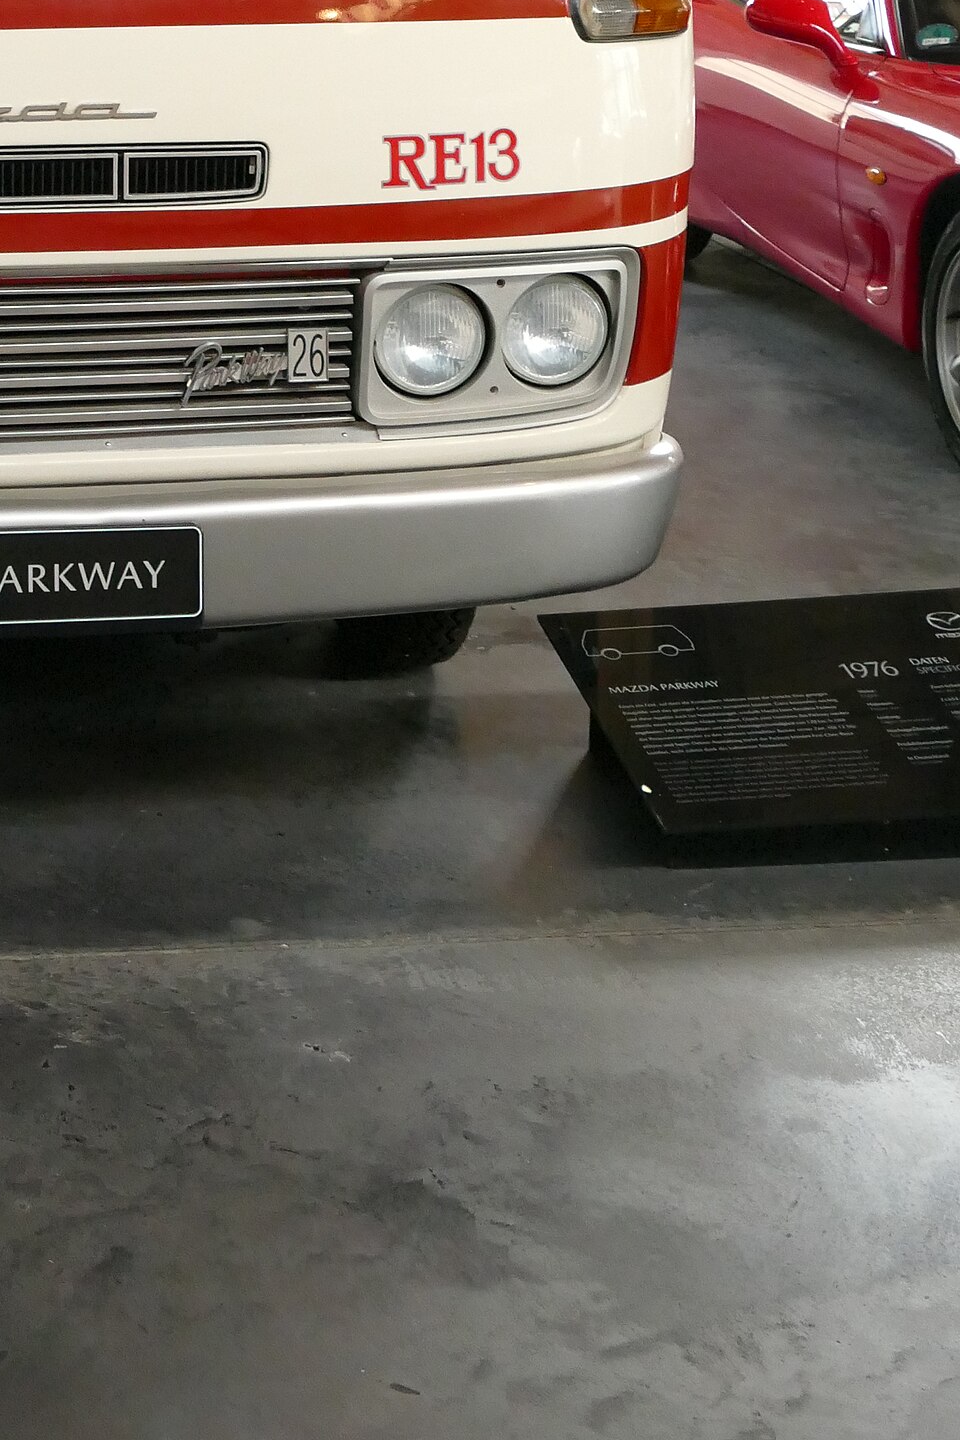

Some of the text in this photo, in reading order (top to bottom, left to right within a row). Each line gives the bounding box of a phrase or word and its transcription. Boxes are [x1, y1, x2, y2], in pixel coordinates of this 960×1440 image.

[381, 127, 520, 191] RE13
[293, 333, 324, 377] 26
[838, 660, 899, 678] 1976
[908, 656, 949, 666] DATEN
[608, 680, 718, 694] MAZDA PARKWAY
